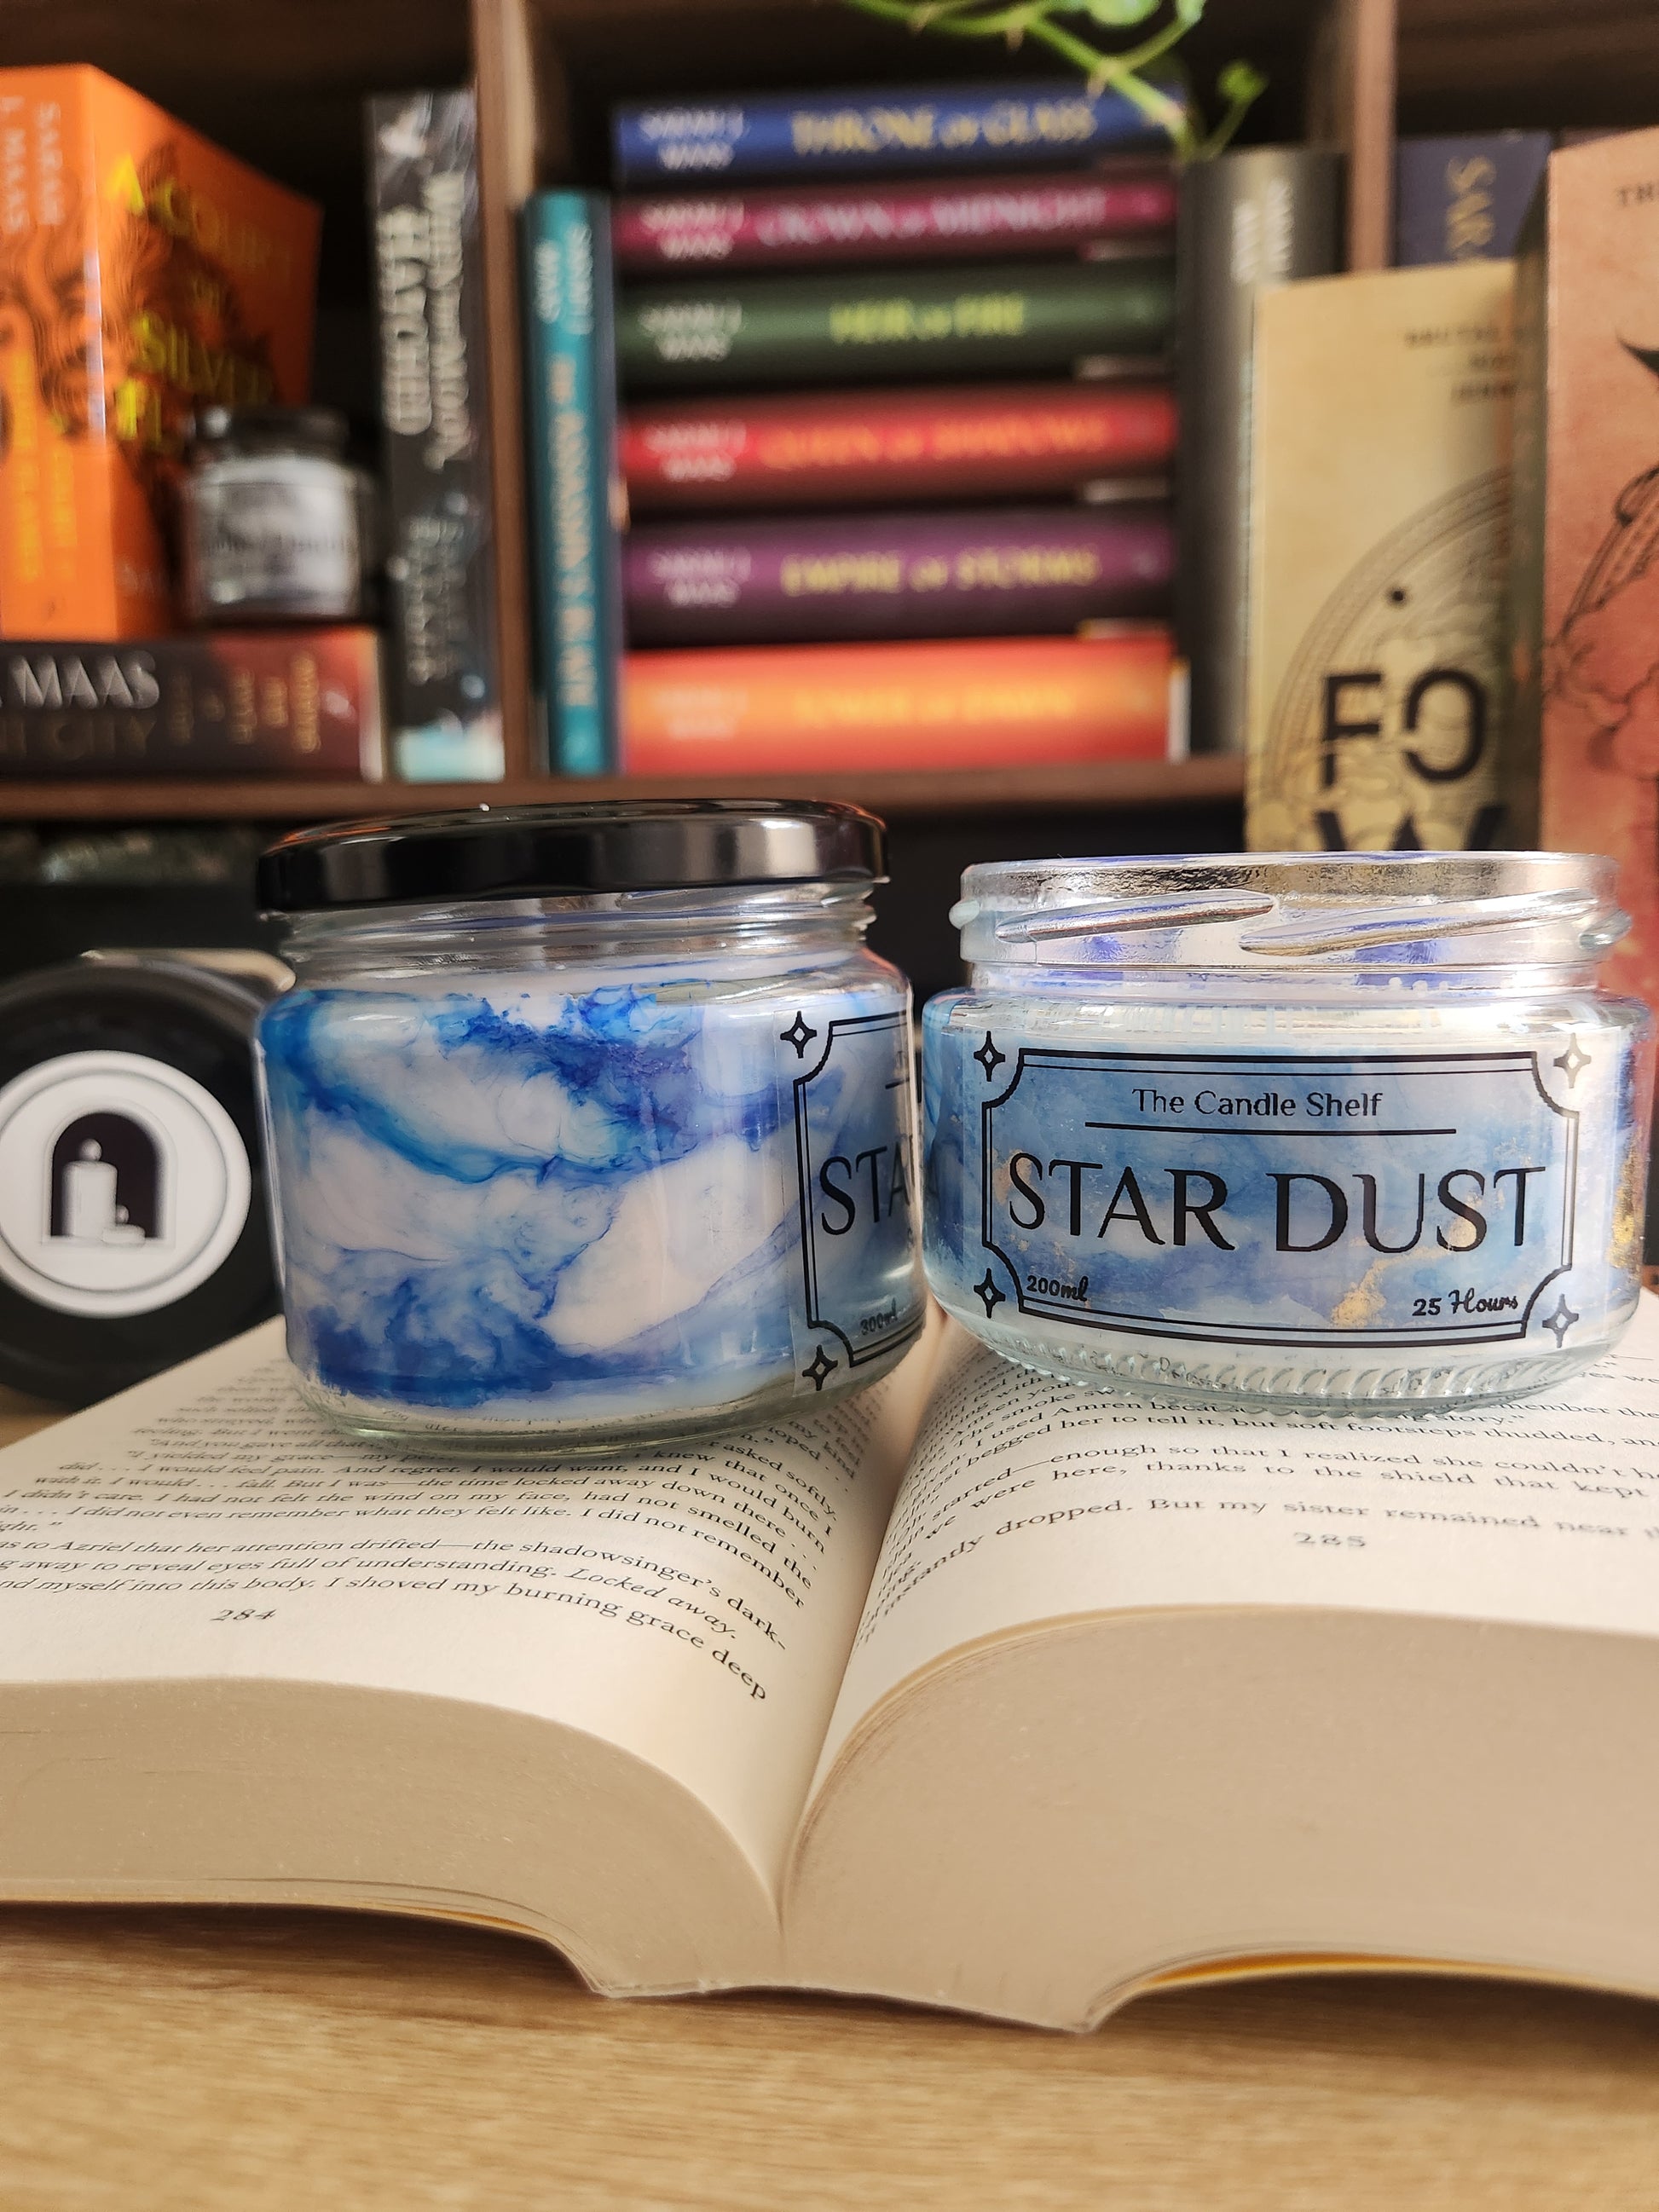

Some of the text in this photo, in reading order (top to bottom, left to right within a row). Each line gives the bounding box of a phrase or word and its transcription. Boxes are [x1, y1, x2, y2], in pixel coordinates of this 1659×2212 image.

[1132, 1088, 1384, 1118] The Candle Shelf
[1009, 1152, 1546, 1254] STAR DUST
[1026, 1275, 1090, 1302] 200ml
[1412, 1289, 1518, 1318] 25 Hours
[995, 1376, 1045, 1399] with
[1000, 1391, 1077, 1423] smoke
[966, 1424, 1052, 1468] begged
[1060, 1416, 1104, 1429] her
[1147, 1415, 1188, 1425] tell
[1196, 1417, 1225, 1428] it,
[1232, 1418, 1281, 1429] but
[1286, 1421, 1340, 1431] soft
[1346, 1422, 1477, 1439] footsteps
[1483, 1428, 1616, 1446] thudded,
[991, 1412, 1044, 1440] used
[1052, 1401, 1143, 1418] Amren
[722, 1442, 784, 1473] asked
[1211, 1445, 1269, 1458] that
[1278, 1449, 1291, 1458] I
[1303, 1451, 1422, 1464] realized
[1432, 1455, 1483, 1468] she
[647, 1450, 716, 1462] knew
[725, 1460, 768, 1482] that
[775, 1483, 819, 1522] once
[970, 1479, 1037, 1509] were
[1052, 1464, 1128, 1481] here,
[1146, 1460, 1246, 1474] thanks
[1265, 1465, 1294, 1475] to
[1314, 1465, 1363, 1478] the
[1379, 1469, 1476, 1485] shield
[1494, 1475, 1559, 1490] that
[1572, 1480, 1650, 1499] kept
[332, 1464, 386, 1474] And
[390, 1465, 461, 1476] regret.
[569, 1464, 628, 1474] want,
[638, 1464, 684, 1475] and
[689, 1467, 701, 1476] I
[708, 1472, 777, 1509] would
[782, 1505, 826, 1555] burn
[458, 1478, 509, 1487] time
[512, 1476, 592, 1487] locked
[594, 1477, 656, 1489] away
[662, 1480, 726, 1505] down
[733, 1500, 788, 1539] there
[995, 1499, 1134, 1536] dropped.
[1149, 1498, 1208, 1510] But
[1218, 1500, 1268, 1515] my
[1282, 1500, 1371, 1517] sister
[1384, 1509, 1542, 1528] remained
[1553, 1520, 1630, 1536] near
[84, 1506, 130, 1517] did
[225, 1507, 350, 1519] remember
[356, 1507, 414, 1516] what
[416, 1506, 472, 1518] they
[475, 1505, 517, 1516] felt
[523, 1505, 572, 1517] like.
[580, 1508, 594, 1517] I
[598, 1509, 641, 1522] did
[644, 1517, 688, 1533] not
[691, 1528, 805, 1609] remember
[172, 1493, 222, 1503] had
[268, 1493, 310, 1503] felt
[315, 1493, 356, 1502] the
[365, 1492, 425, 1501] wind
[468, 1493, 509, 1503] my
[516, 1491, 571, 1502] face,
[581, 1491, 631, 1503] had
[637, 1496, 681, 1510] not
[687, 1505, 777, 1556] smelled
[783, 1556, 812, 1591] the
[1292, 1531, 1367, 1549] 285
[19, 1556, 737, 1640] away to reveal eyes full of understanding. Locked away.
[23, 1541, 49, 1550] to
[50, 1540, 136, 1551] Azriel
[132, 1542, 182, 1552] that
[184, 1542, 230, 1552] her
[231, 1540, 344, 1552] attention
[726, 1596, 786, 1650] dark-
[210, 1608, 277, 1621] 284
[33, 1575, 767, 1703] myself into this body. I shoved my burning grace deep
